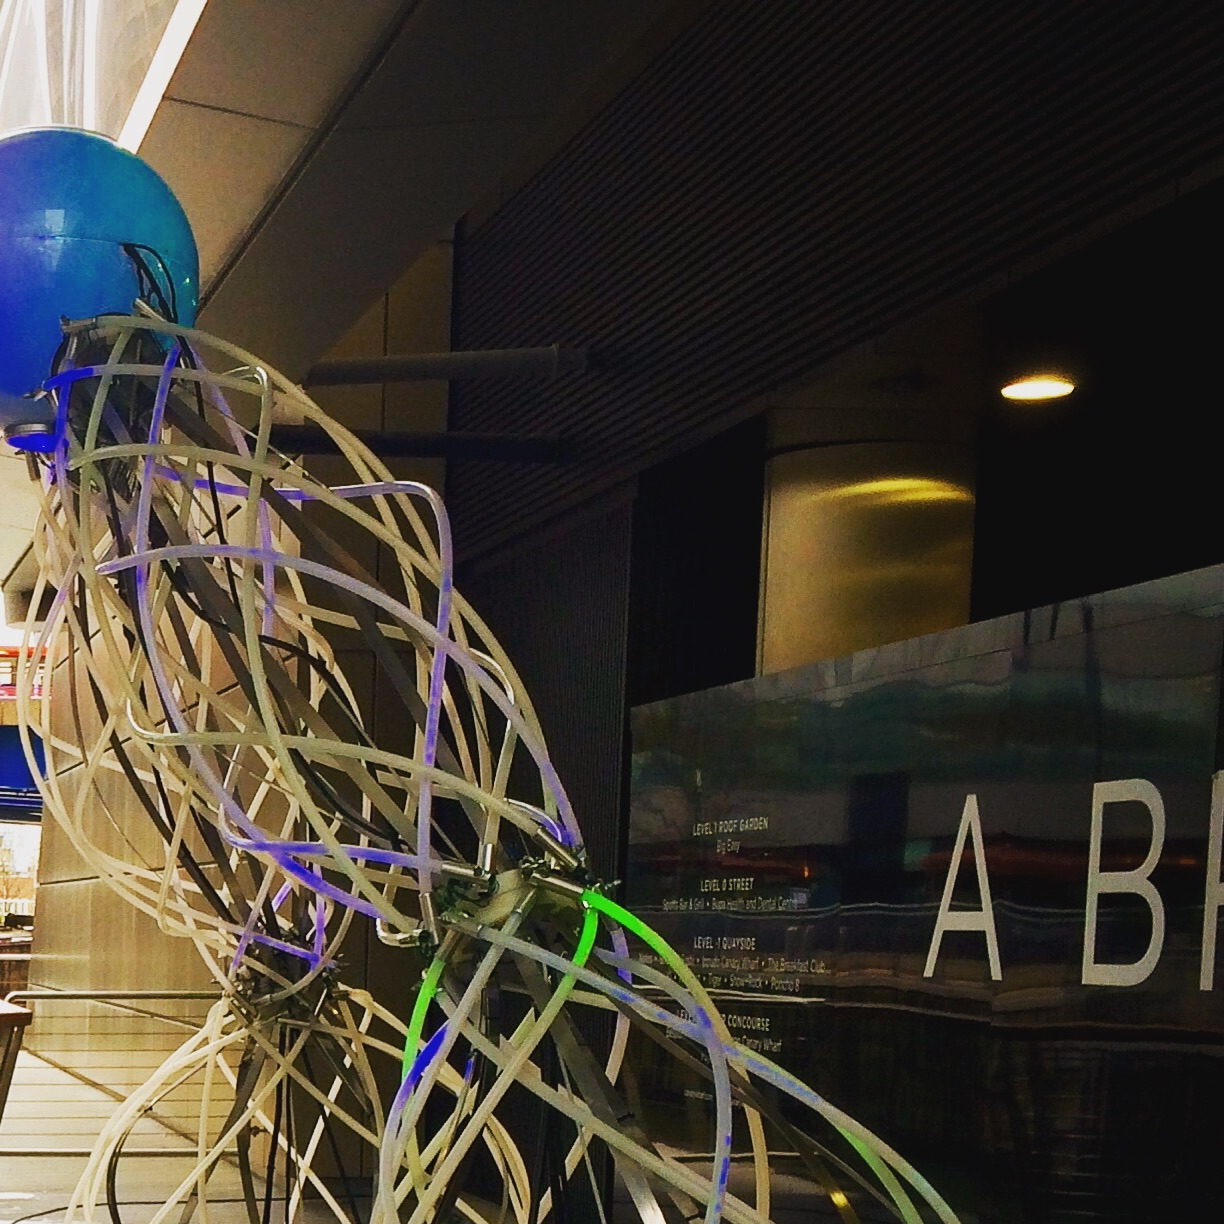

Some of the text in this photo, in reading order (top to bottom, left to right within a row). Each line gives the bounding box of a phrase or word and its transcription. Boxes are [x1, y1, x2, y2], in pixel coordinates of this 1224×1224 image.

[693, 822, 713, 836] LEVEL
[719, 819, 738, 834] ROOF
[739, 816, 769, 832] GARDEN
[716, 839, 726, 854] Big
[700, 878, 721, 892] LEVEL
[728, 877, 754, 891] STREET
[745, 897, 757, 910] and
[757, 896, 777, 910] Dental
[694, 937, 714, 949] LEVEL
[722, 937, 756, 951] QUAYSIDE
[721, 954, 740, 972] Canary
[741, 956, 760, 970] Wharf
[768, 957, 779, 971] The
[780, 957, 809, 973] Breakfast
[727, 1014, 770, 1032] CONCOURSE
[762, 1037, 782, 1052] Wharf
